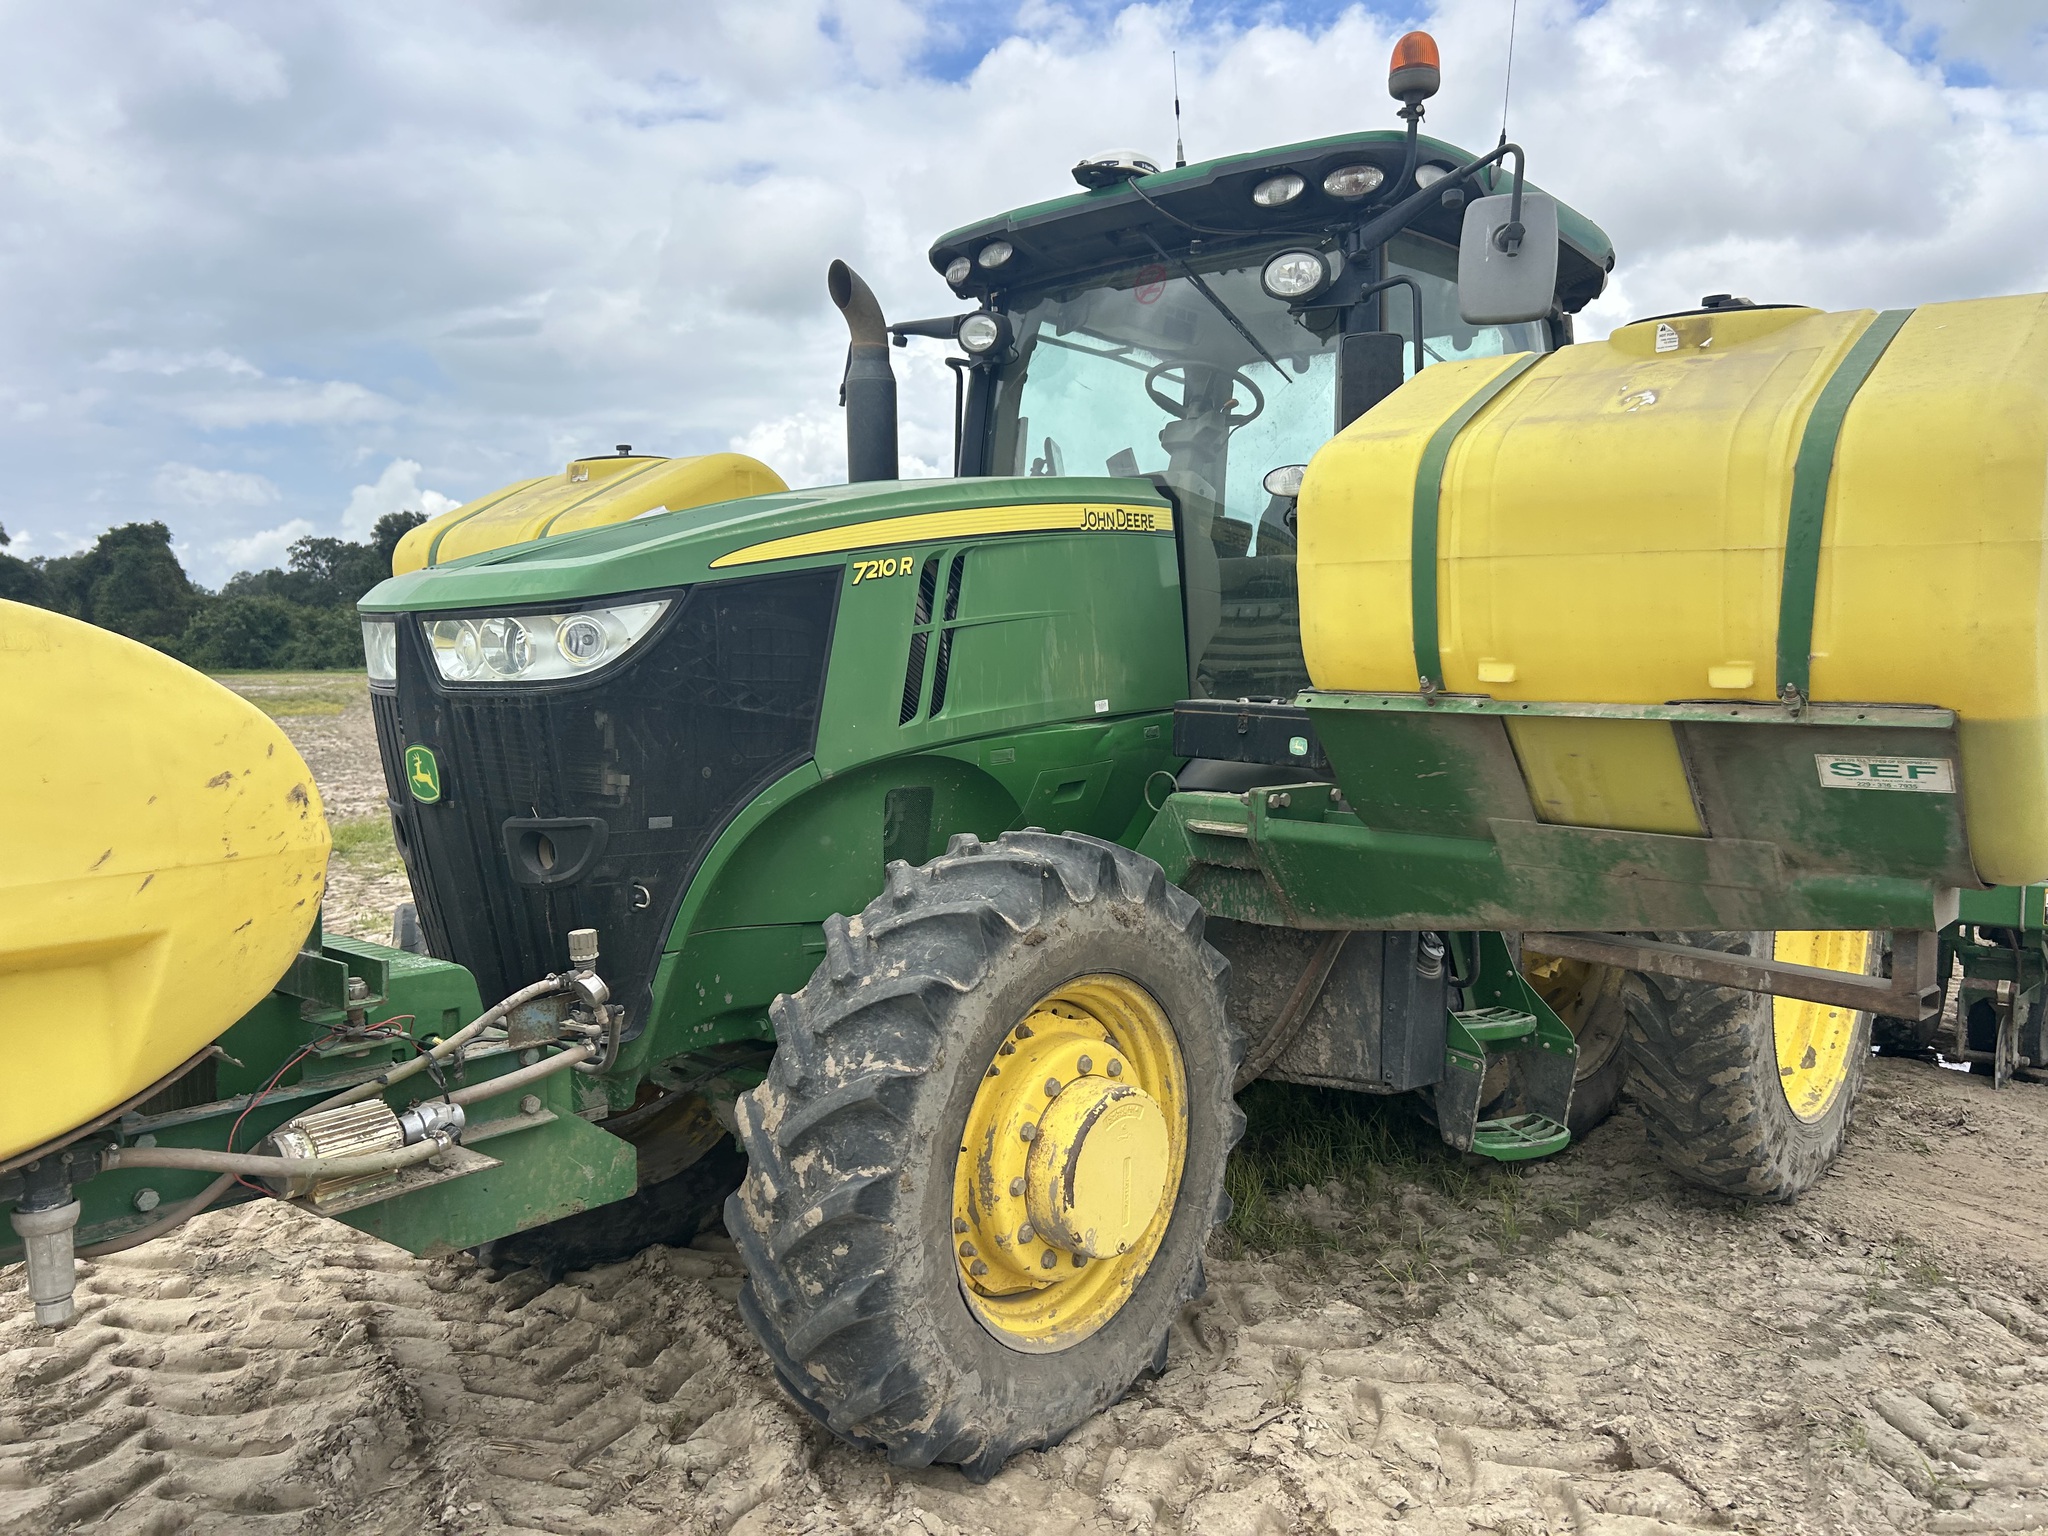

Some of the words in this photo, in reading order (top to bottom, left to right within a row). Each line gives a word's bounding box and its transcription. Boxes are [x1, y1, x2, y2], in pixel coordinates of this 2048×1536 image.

[1081, 508, 1115, 529] JOHN
[1116, 508, 1155, 529] DEERE
[852, 558, 898, 586] 7210
[899, 556, 914, 577] R
[1829, 763, 1938, 779] SEF
